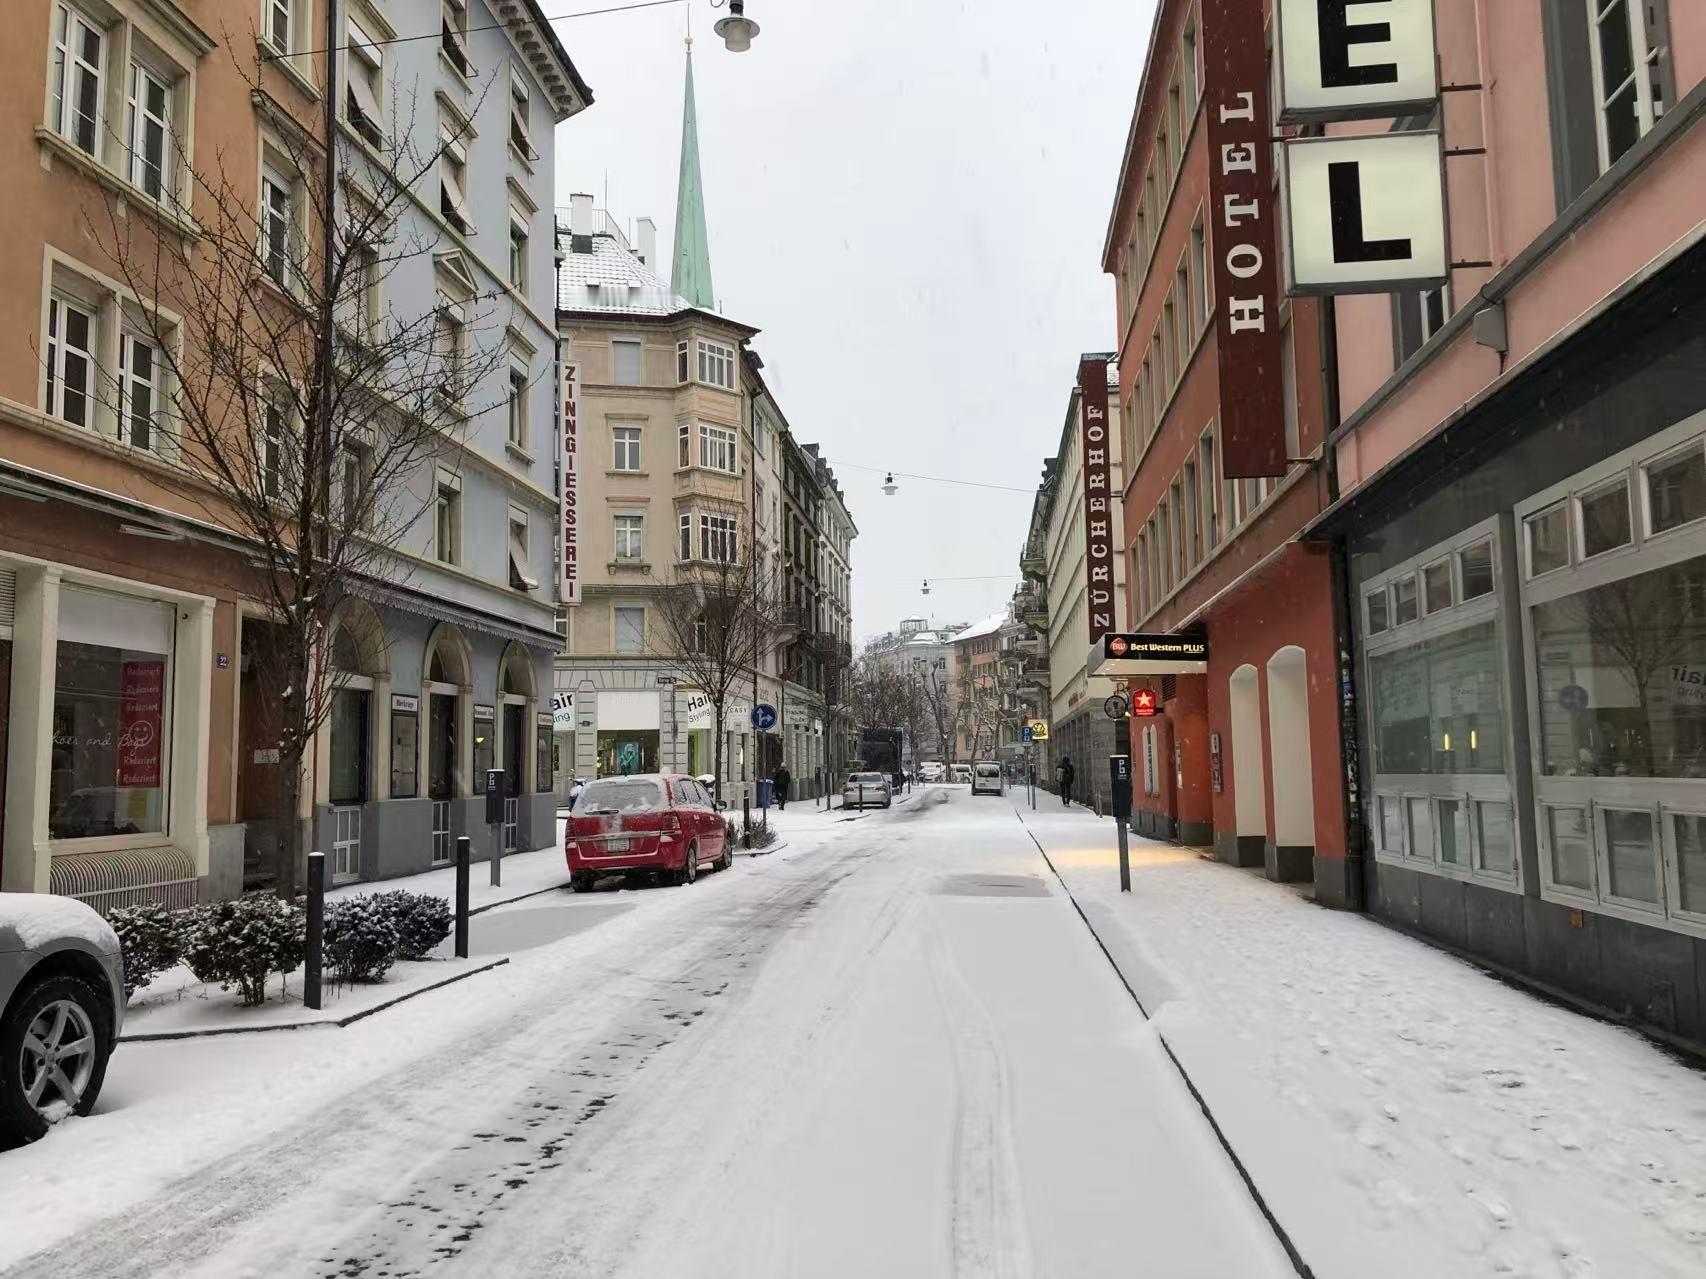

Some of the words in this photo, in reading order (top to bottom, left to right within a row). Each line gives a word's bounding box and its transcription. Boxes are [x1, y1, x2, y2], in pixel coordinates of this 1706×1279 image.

[1219, 90, 1266, 335] HOTEL
[564, 365, 577, 598] ZINNGIESSEREI
[1130, 643, 1148, 651] Best
[1149, 643, 1182, 652] Western
[1183, 644, 1205, 652] PLUS
[219, 655, 227, 666] 22
[688, 708, 711, 723] Styling
[86, 732, 111, 746] and
